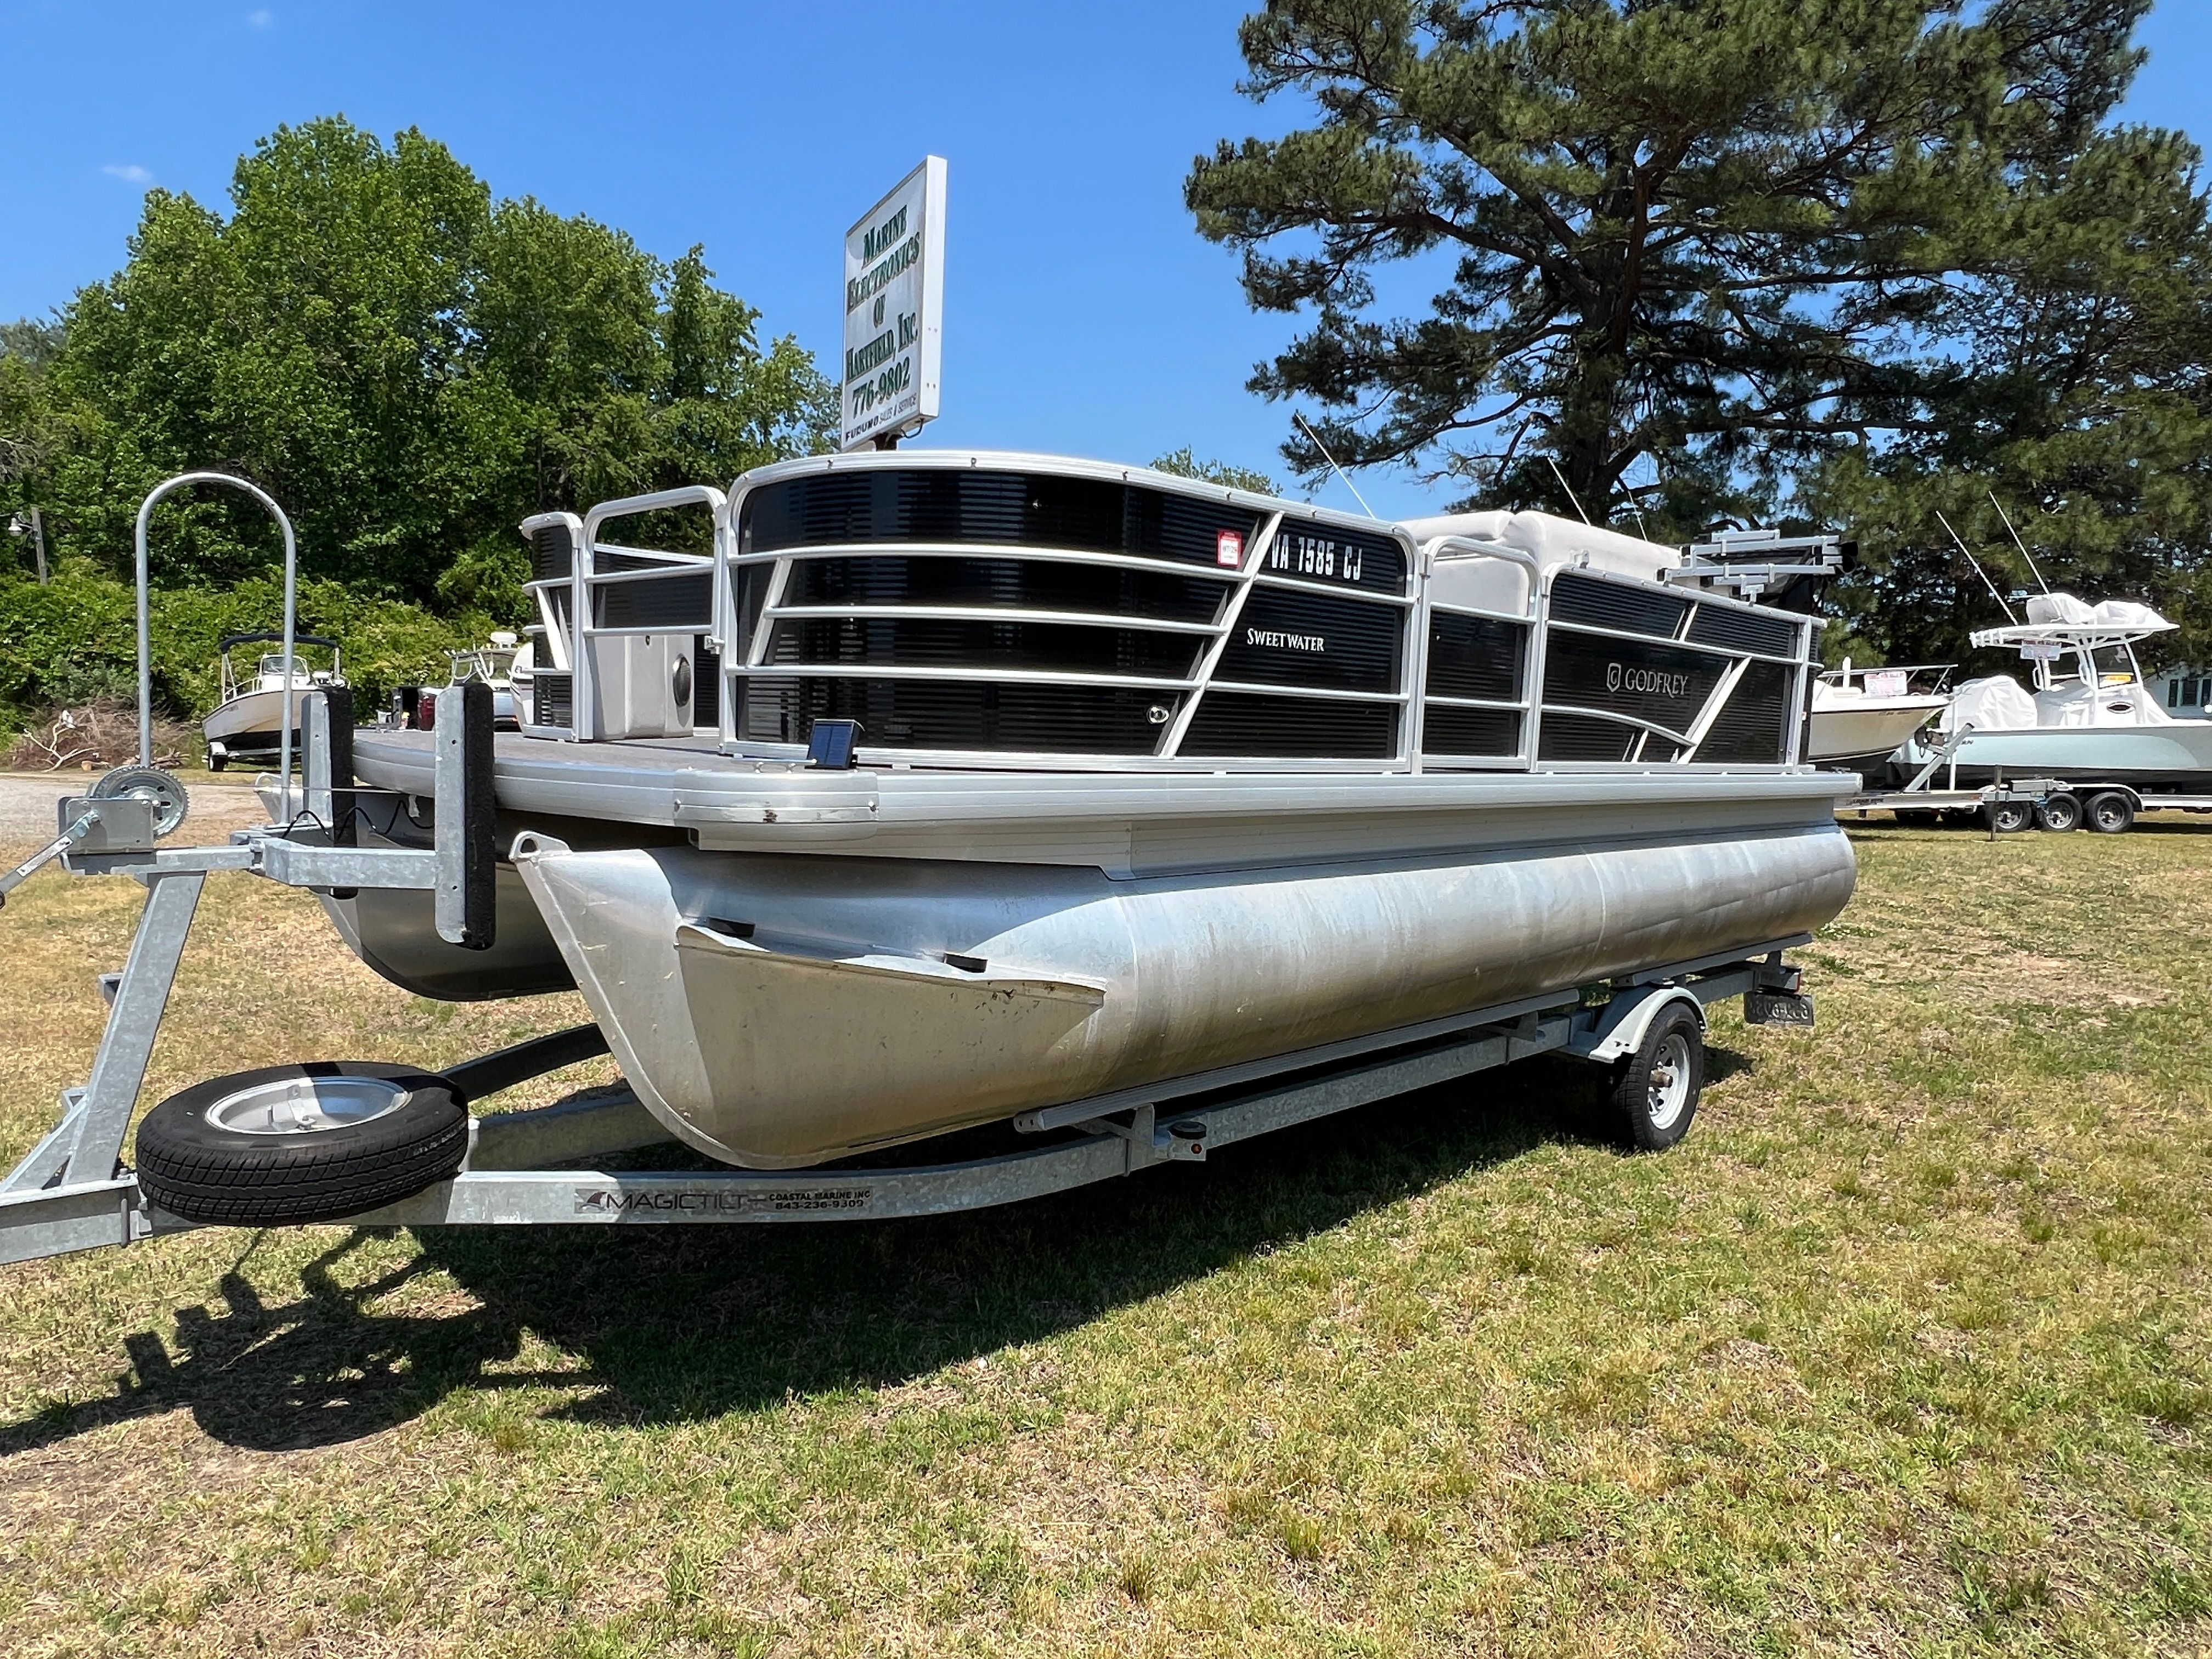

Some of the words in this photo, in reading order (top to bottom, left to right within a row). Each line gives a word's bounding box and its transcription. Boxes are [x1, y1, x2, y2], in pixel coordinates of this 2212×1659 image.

[862, 204, 907, 268] MARINE
[847, 232, 919, 315] ELECTRONICS
[852, 356, 911, 419] 776-9802
[1272, 534, 1289, 569] VA
[1344, 545, 1363, 580] CJ
[1626, 668, 1689, 699] GODFREY
[607, 1193, 748, 1209] MAGICTILT
[769, 1193, 812, 1201] COASTAL
[815, 1191, 851, 1200] MARINE
